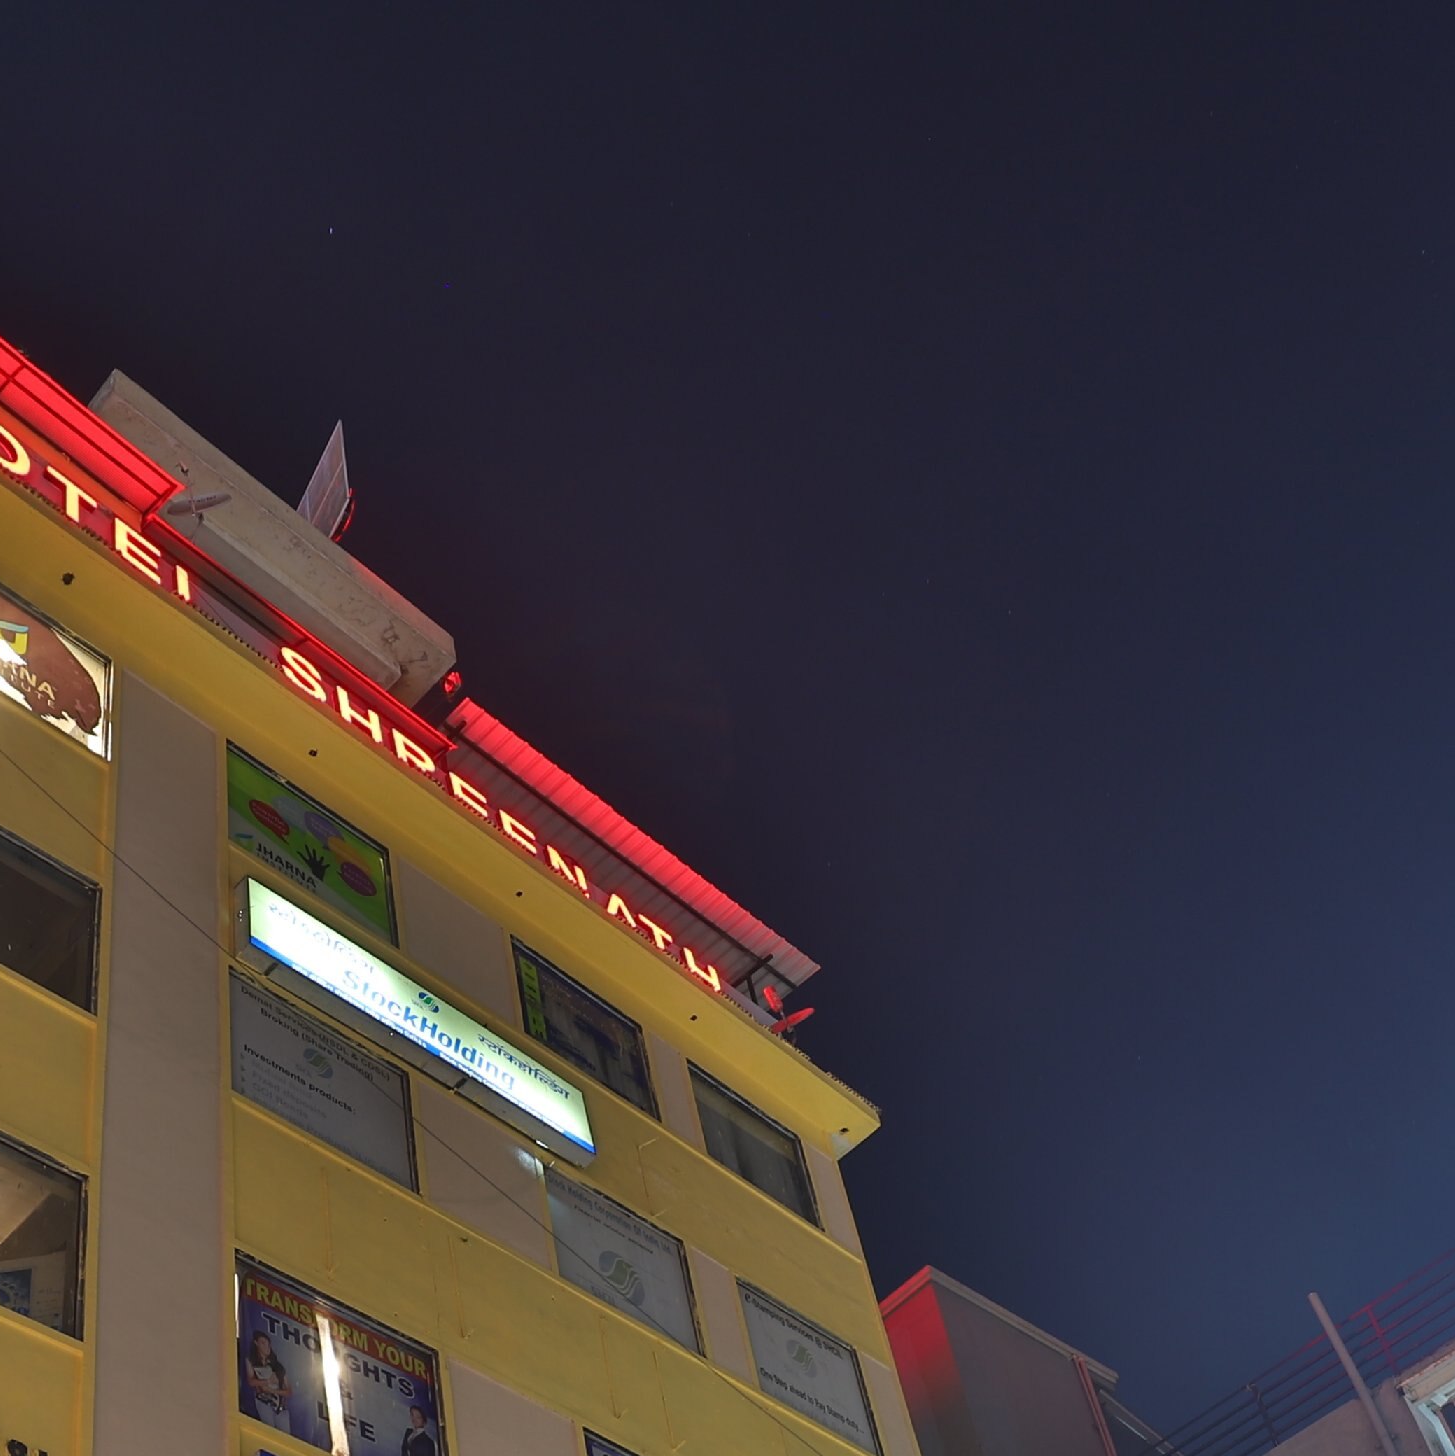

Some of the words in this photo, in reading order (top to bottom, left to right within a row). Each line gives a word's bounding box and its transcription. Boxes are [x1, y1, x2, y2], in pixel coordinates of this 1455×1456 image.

[256, 842, 317, 889] JHARNA
[242, 1041, 306, 1088] Investments
[245, 1277, 369, 1352] TRANSORM
[373, 1340, 428, 1377] YOUR
[261, 1312, 416, 1399] THOGHTS
[318, 1400, 376, 1443] LFE
